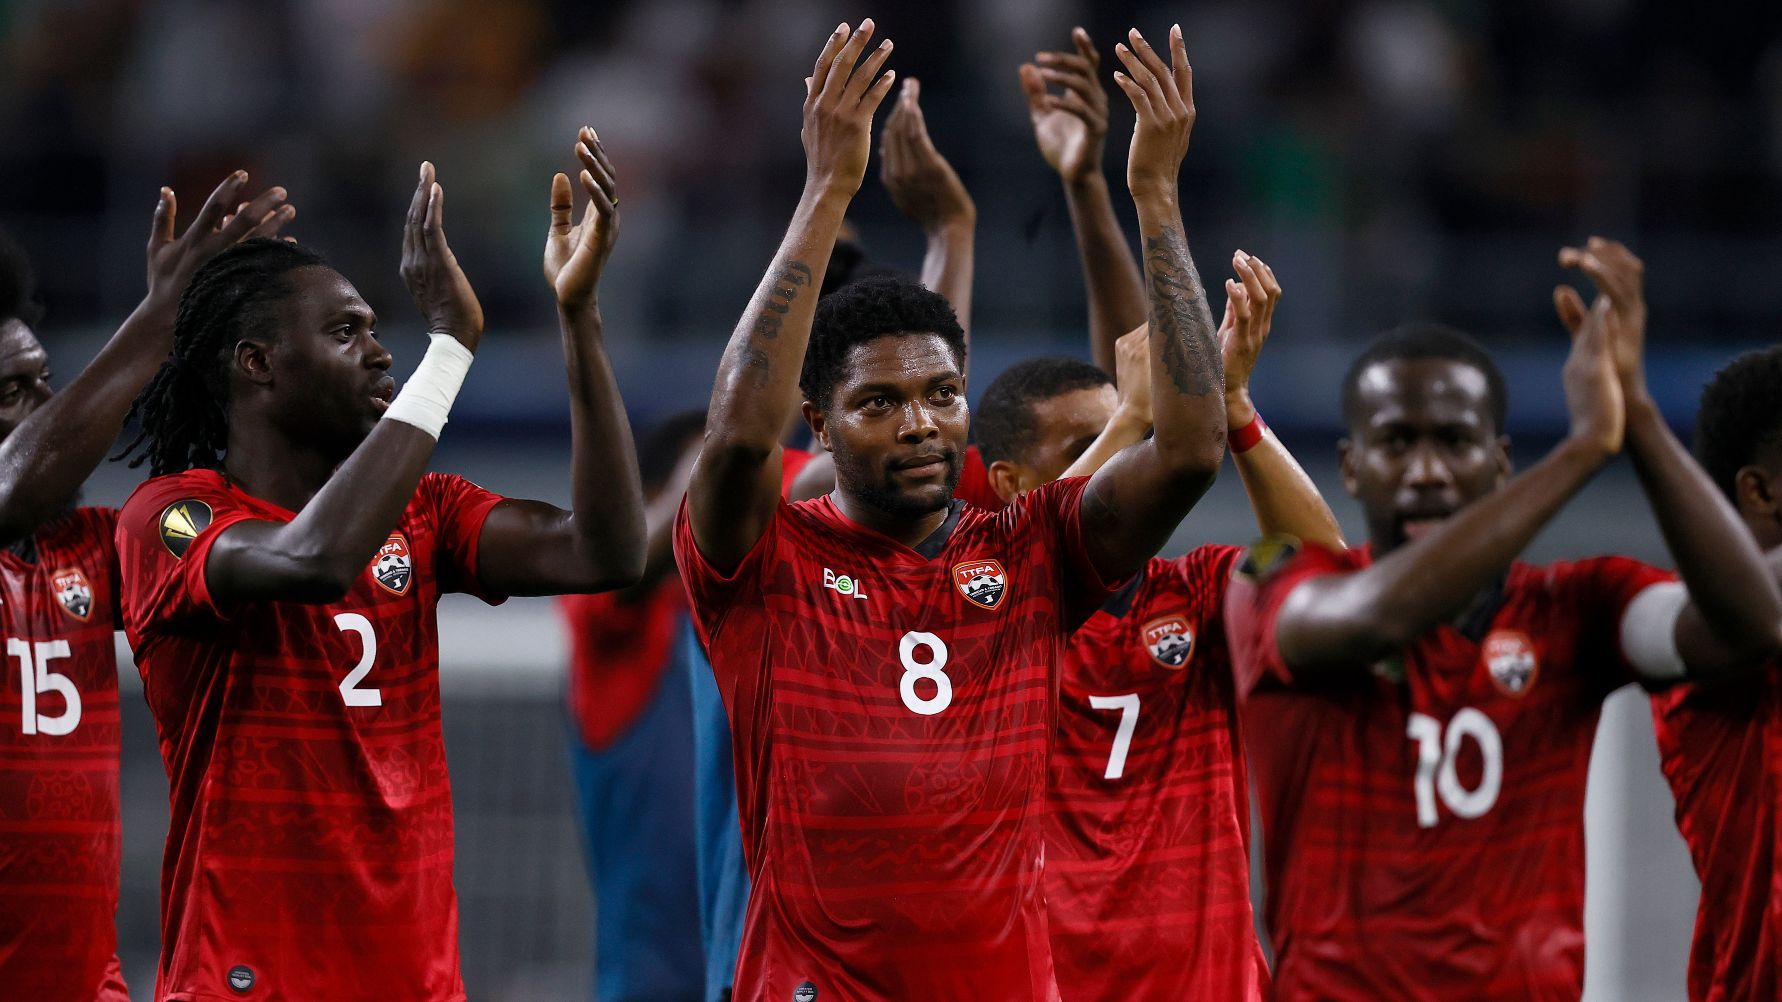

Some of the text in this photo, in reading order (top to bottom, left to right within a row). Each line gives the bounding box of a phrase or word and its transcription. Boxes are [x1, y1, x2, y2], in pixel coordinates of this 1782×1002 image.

[823, 567, 868, 600] BOL
[960, 565, 995, 579] TTFA
[333, 612, 382, 707] 2
[898, 630, 953, 716] 8
[1148, 622, 1182, 638] TTFA
[6, 637, 82, 736] 15
[1088, 693, 1141, 780] 7
[1407, 707, 1503, 827] 10
